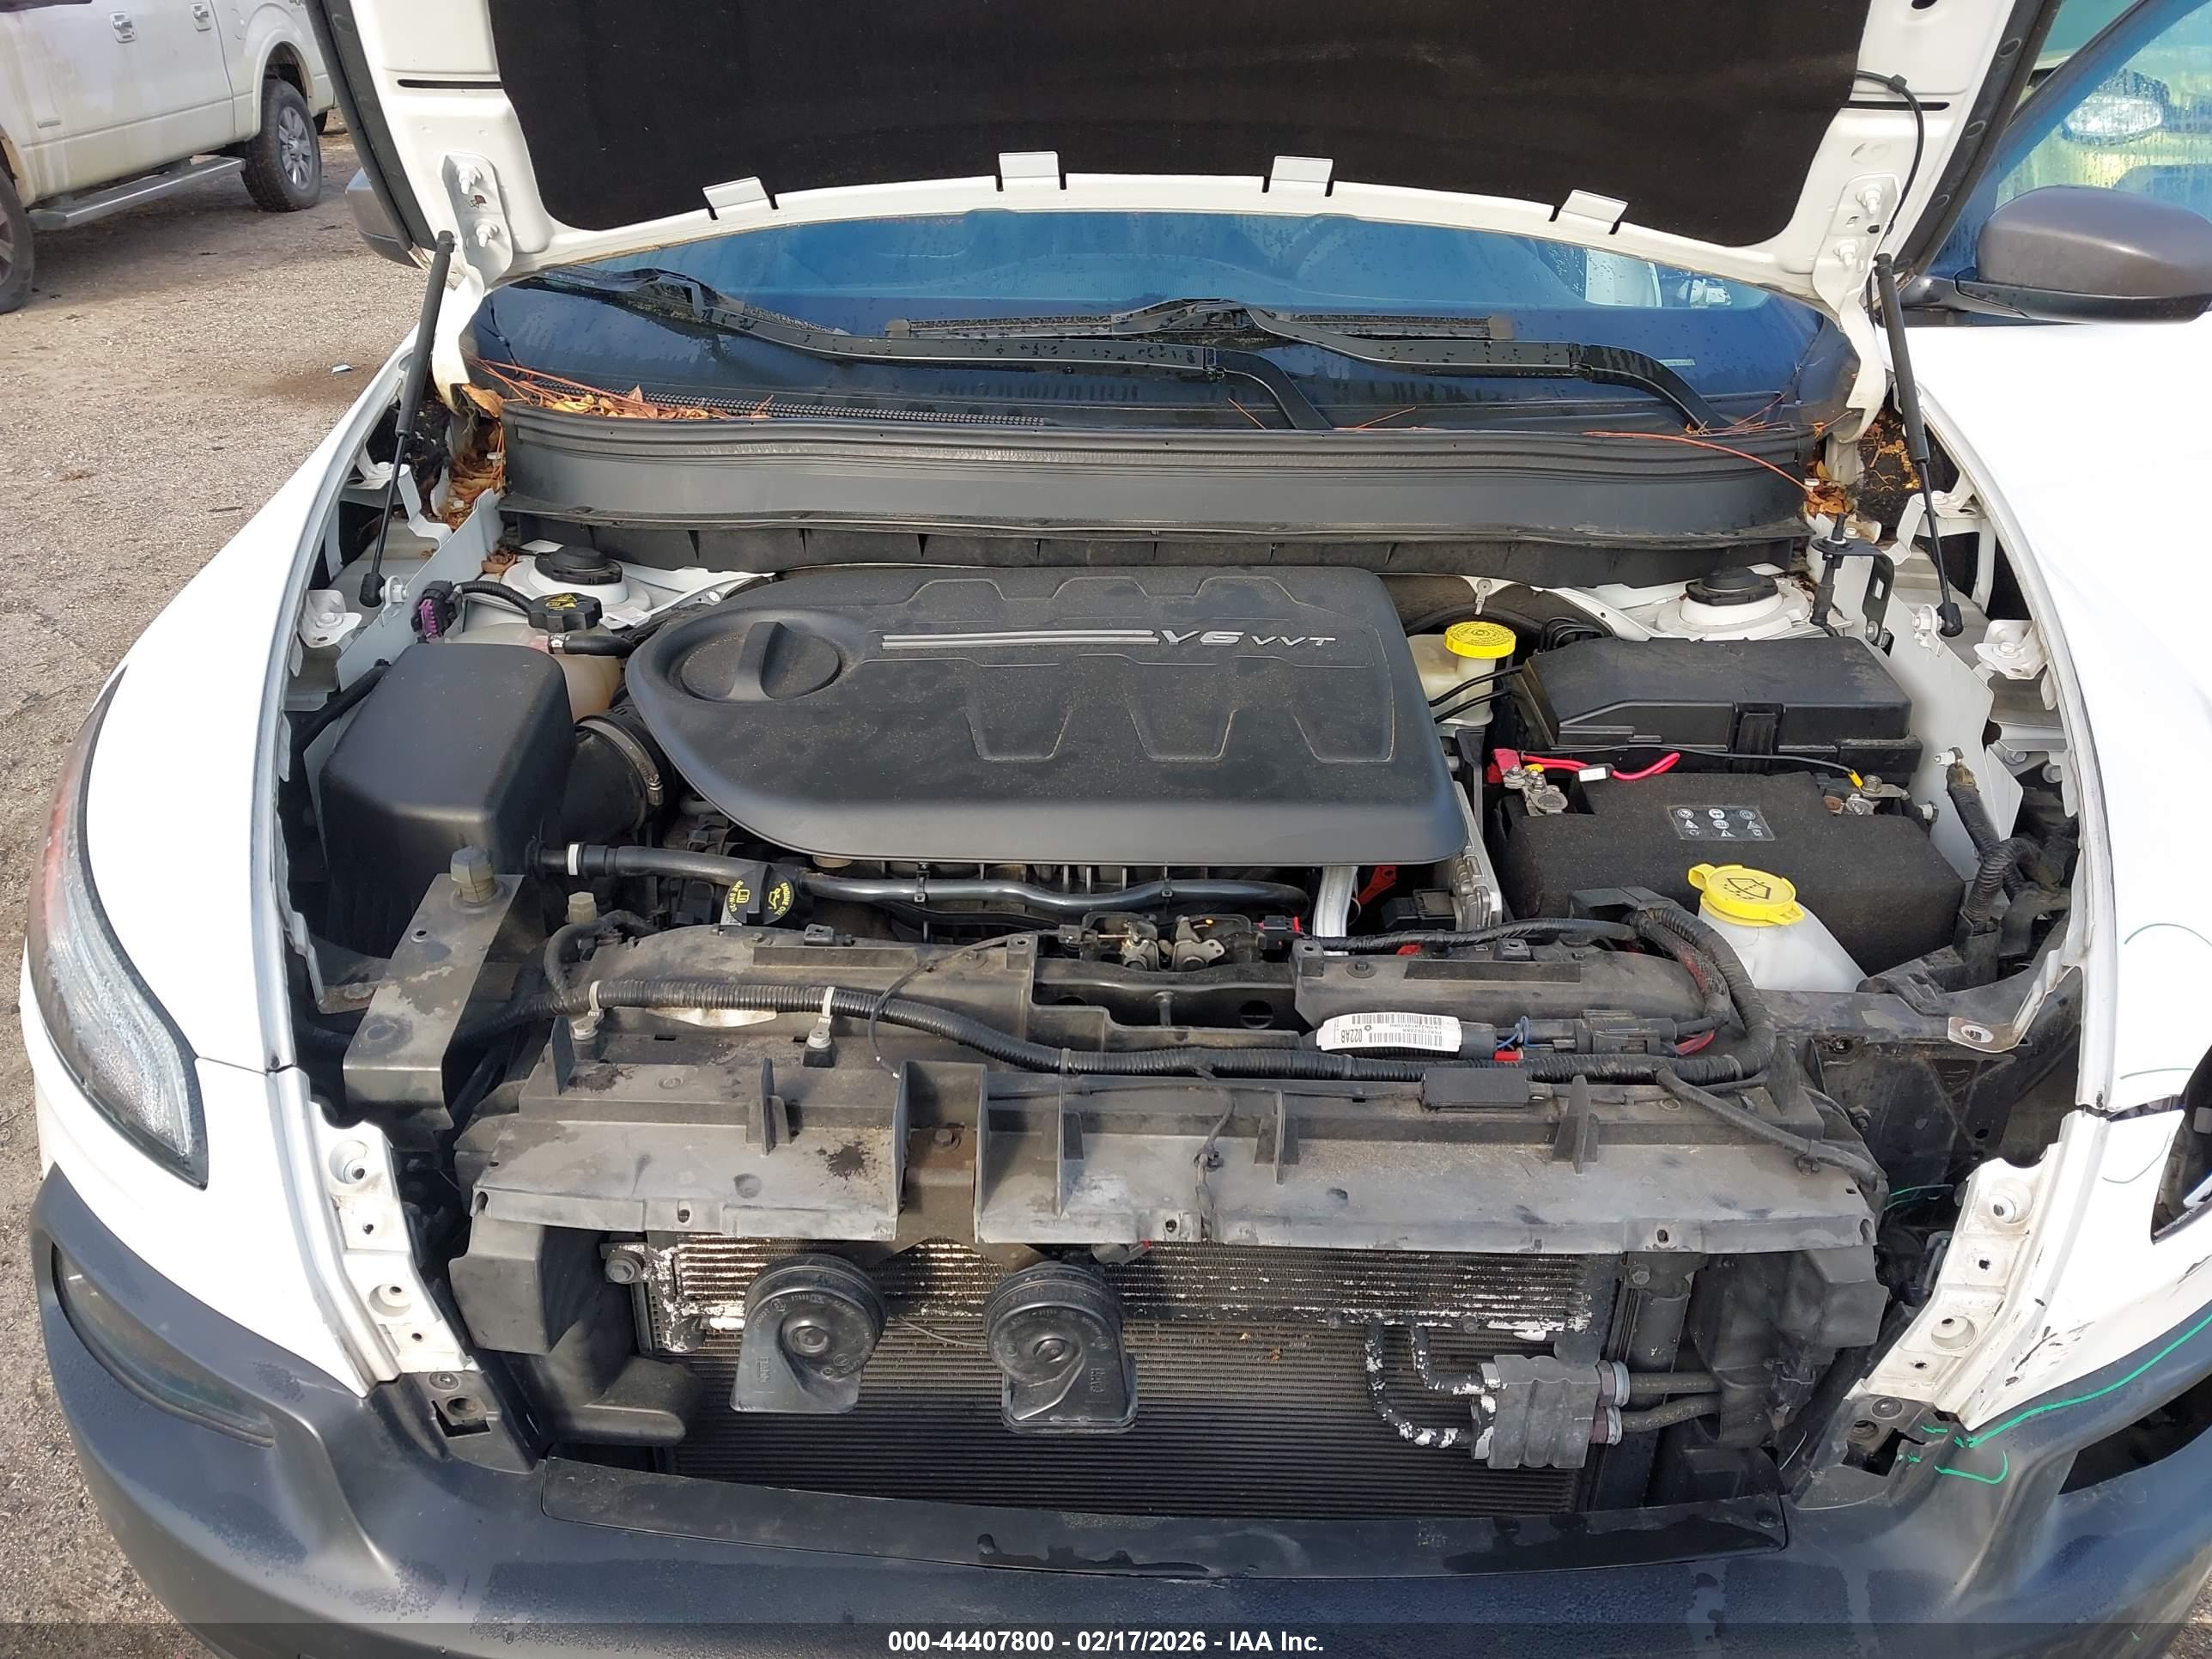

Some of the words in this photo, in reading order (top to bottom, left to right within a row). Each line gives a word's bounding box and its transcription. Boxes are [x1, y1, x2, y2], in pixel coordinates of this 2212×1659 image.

[1160, 630, 1245, 646] V6
[1251, 635, 1337, 647] VVT
[780, 882, 791, 906] ENGINE
[774, 906, 787, 916] OIL
[1341, 1030, 1363, 1044] 022AB
